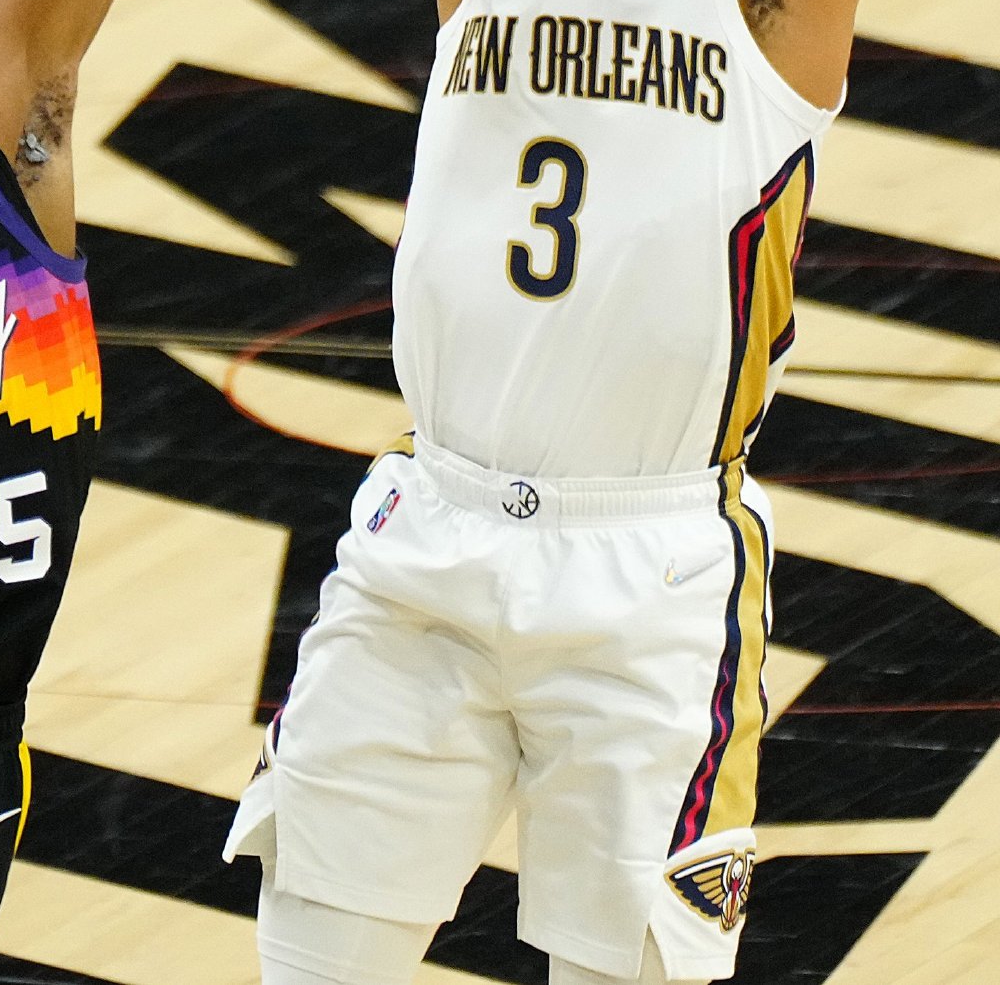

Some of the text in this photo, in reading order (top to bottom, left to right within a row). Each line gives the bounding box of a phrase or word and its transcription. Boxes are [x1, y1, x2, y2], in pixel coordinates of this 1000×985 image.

[443, 14, 727, 123] NEW ORLEANS
[506, 135, 588, 302] 3
